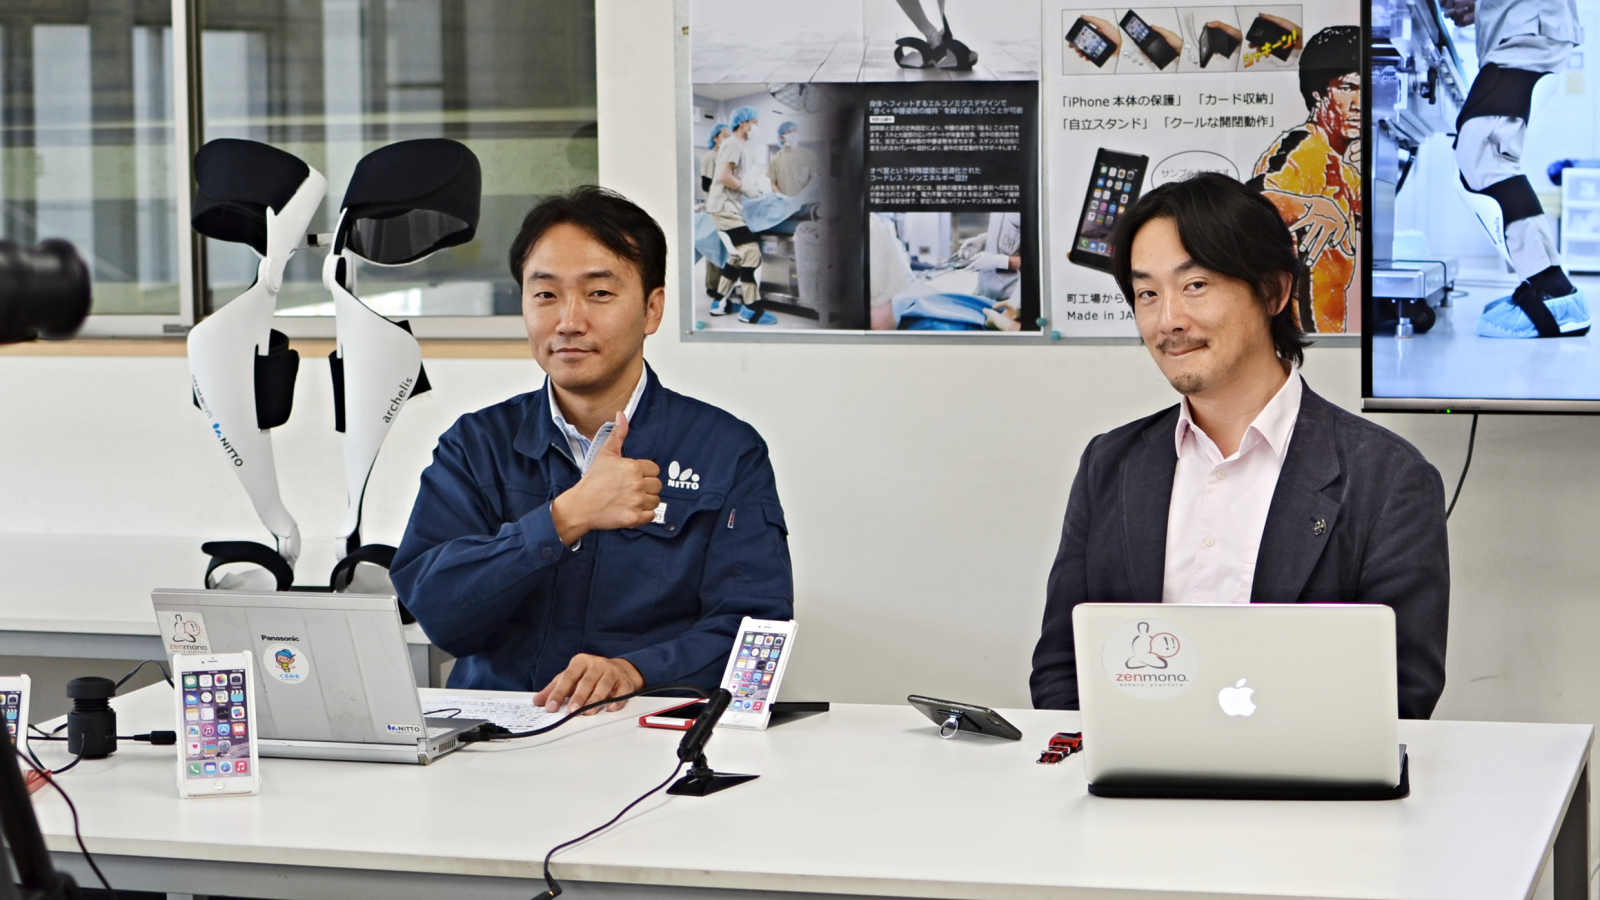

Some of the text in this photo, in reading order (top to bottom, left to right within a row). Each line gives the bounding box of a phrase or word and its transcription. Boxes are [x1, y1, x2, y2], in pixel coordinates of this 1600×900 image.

[1113, 93, 1182, 107] 本体の保護」
[1198, 92, 1275, 106] 「カード収納」
[1063, 116, 1275, 131] 「自立スタンド」 「クールな開閉動作」
[1066, 293, 1125, 304] 町工場から
[1067, 311, 1134, 321] Made in JA
[382, 376, 413, 424] archelis
[220, 437, 244, 467] NITTO
[667, 479, 700, 491] NITTO
[260, 634, 300, 642] Panasonic
[1116, 673, 1187, 682] zenmono
